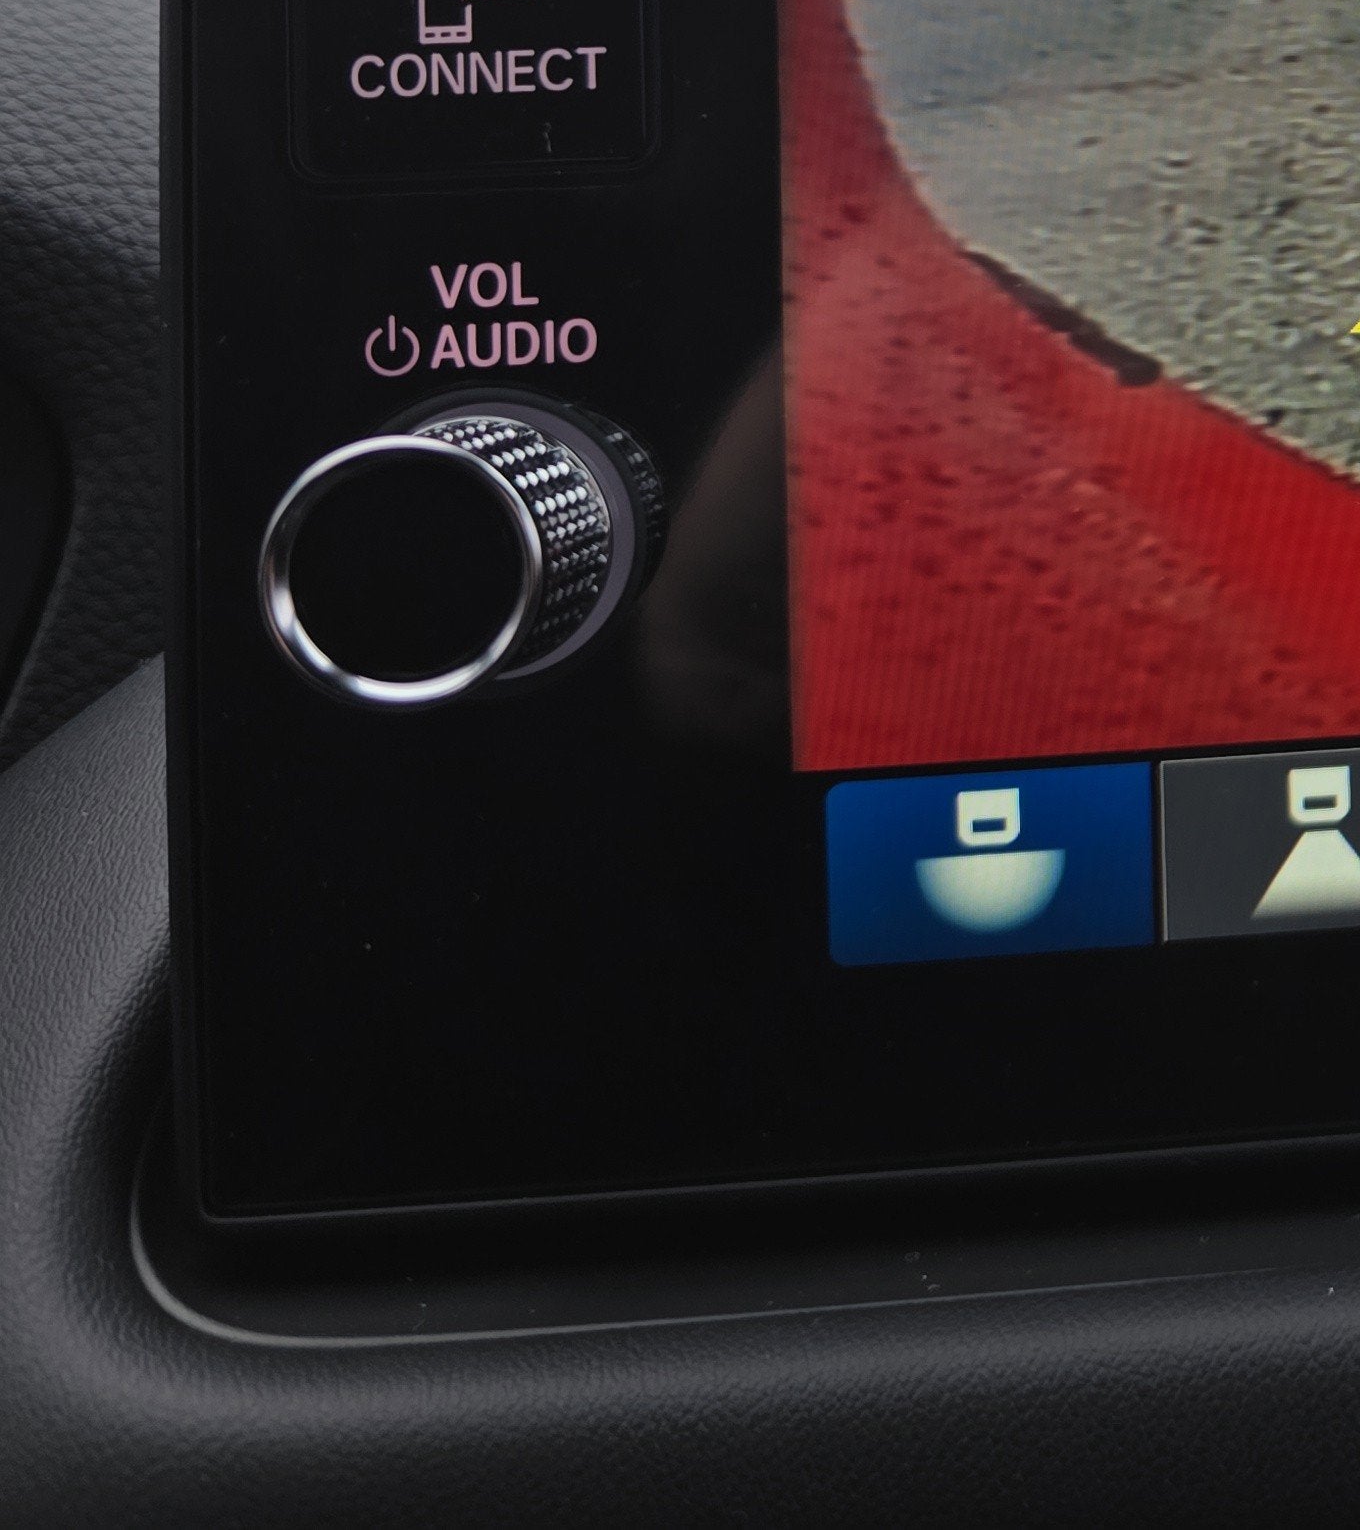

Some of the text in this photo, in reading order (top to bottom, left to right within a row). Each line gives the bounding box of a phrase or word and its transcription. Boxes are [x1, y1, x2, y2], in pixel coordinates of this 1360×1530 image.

[351, 47, 607, 98] CONNECT
[431, 262, 539, 309] VOL
[431, 318, 598, 369] AUDIO
